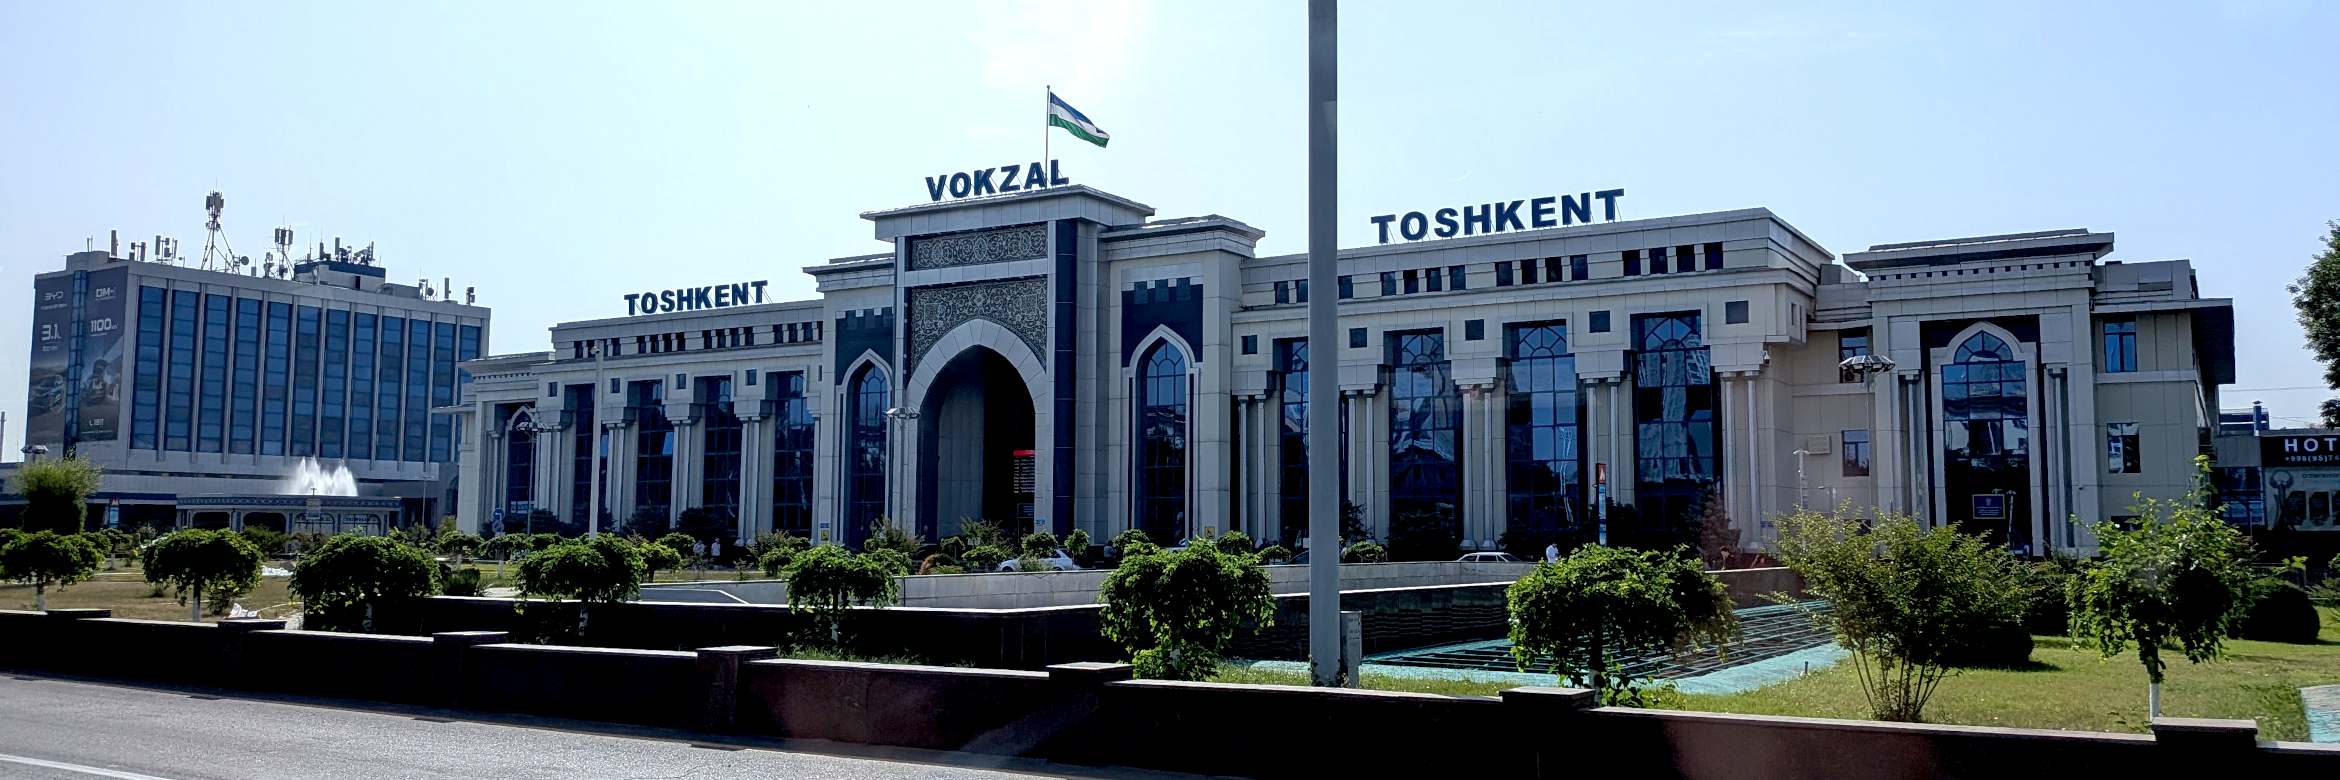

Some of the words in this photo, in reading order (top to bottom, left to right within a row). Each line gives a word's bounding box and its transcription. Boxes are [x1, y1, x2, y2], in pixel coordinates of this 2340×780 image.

[925, 159, 1069, 201] VOKZAL
[1371, 188, 1624, 244] TOSHKENT
[624, 280, 768, 315] TOSHKENT
[2284, 438, 2337, 452] HOT
